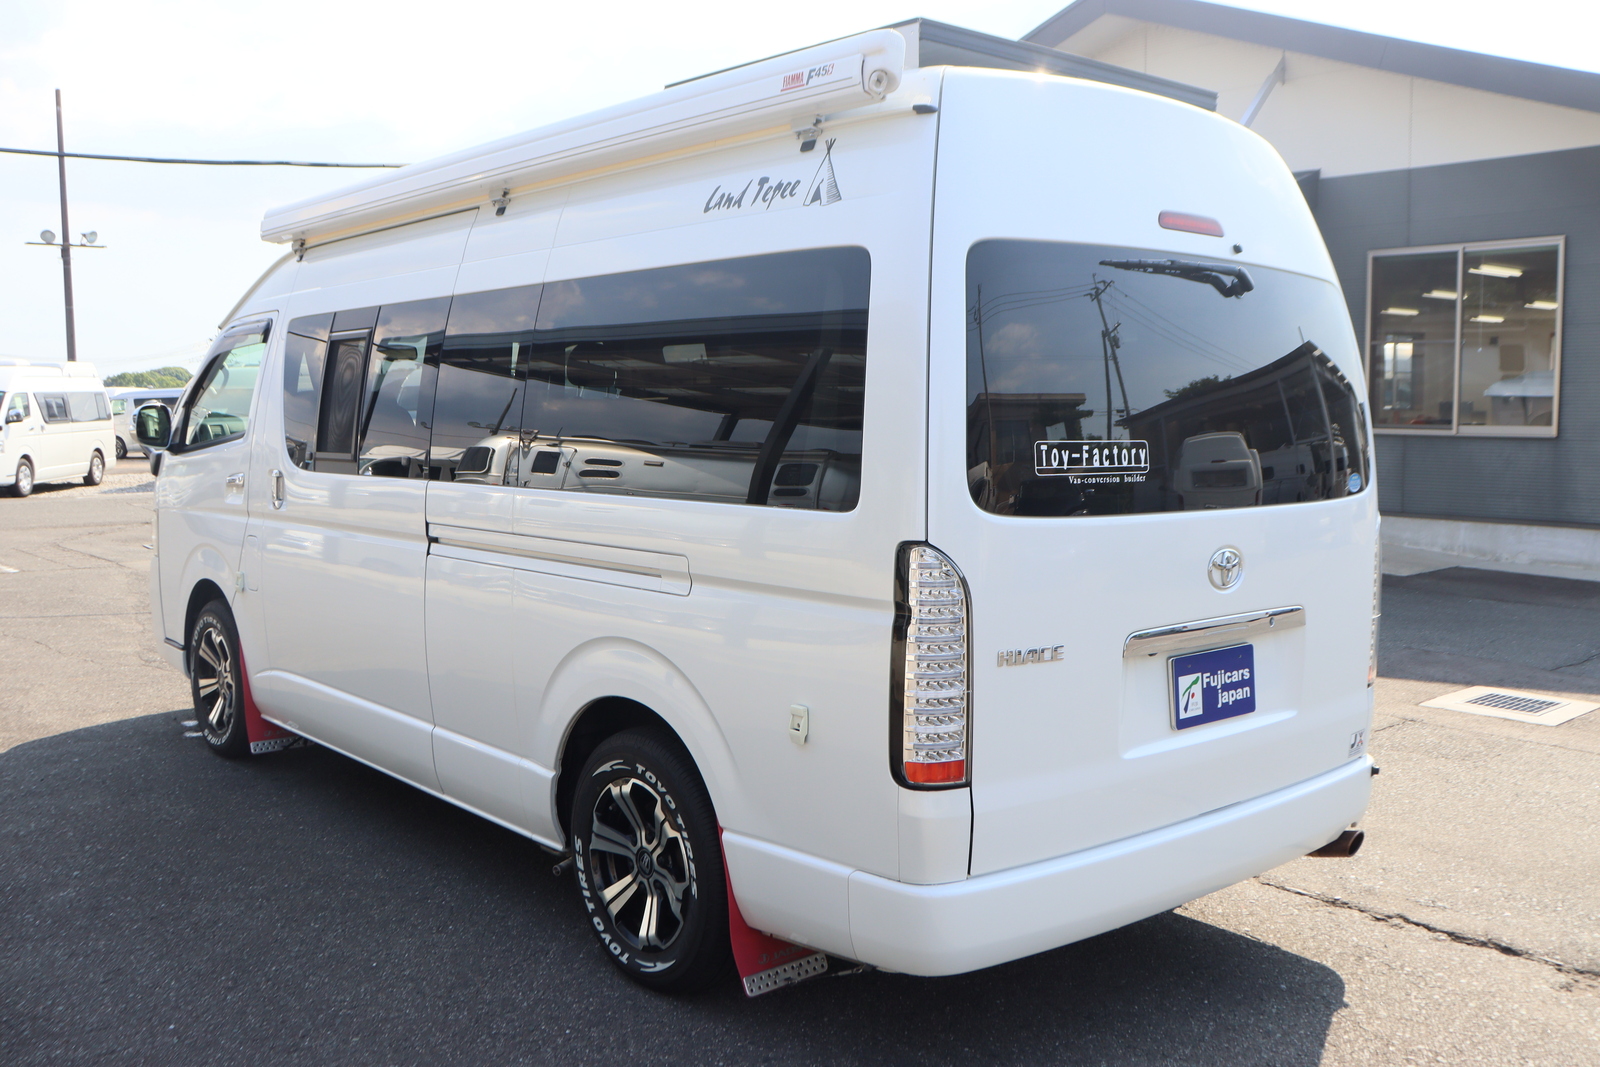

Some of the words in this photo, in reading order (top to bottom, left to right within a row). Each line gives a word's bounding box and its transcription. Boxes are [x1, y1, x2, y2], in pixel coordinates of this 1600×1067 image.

[782, 71, 804, 88] FIAMMA
[703, 179, 753, 214] Land
[750, 176, 801, 210] Tepee
[1040, 444, 1146, 470] Toy-Factory
[1068, 475, 1120, 485] Van-conversion
[1124, 474, 1146, 483] builder
[997, 644, 1064, 667] HIACE
[1203, 668, 1250, 689] Fujicars
[1217, 686, 1251, 708] japan
[635, 763, 676, 810] TOYO
[677, 813, 698, 900] TIRES
[574, 835, 596, 913] TIRES
[592, 916, 631, 965] TOYO
